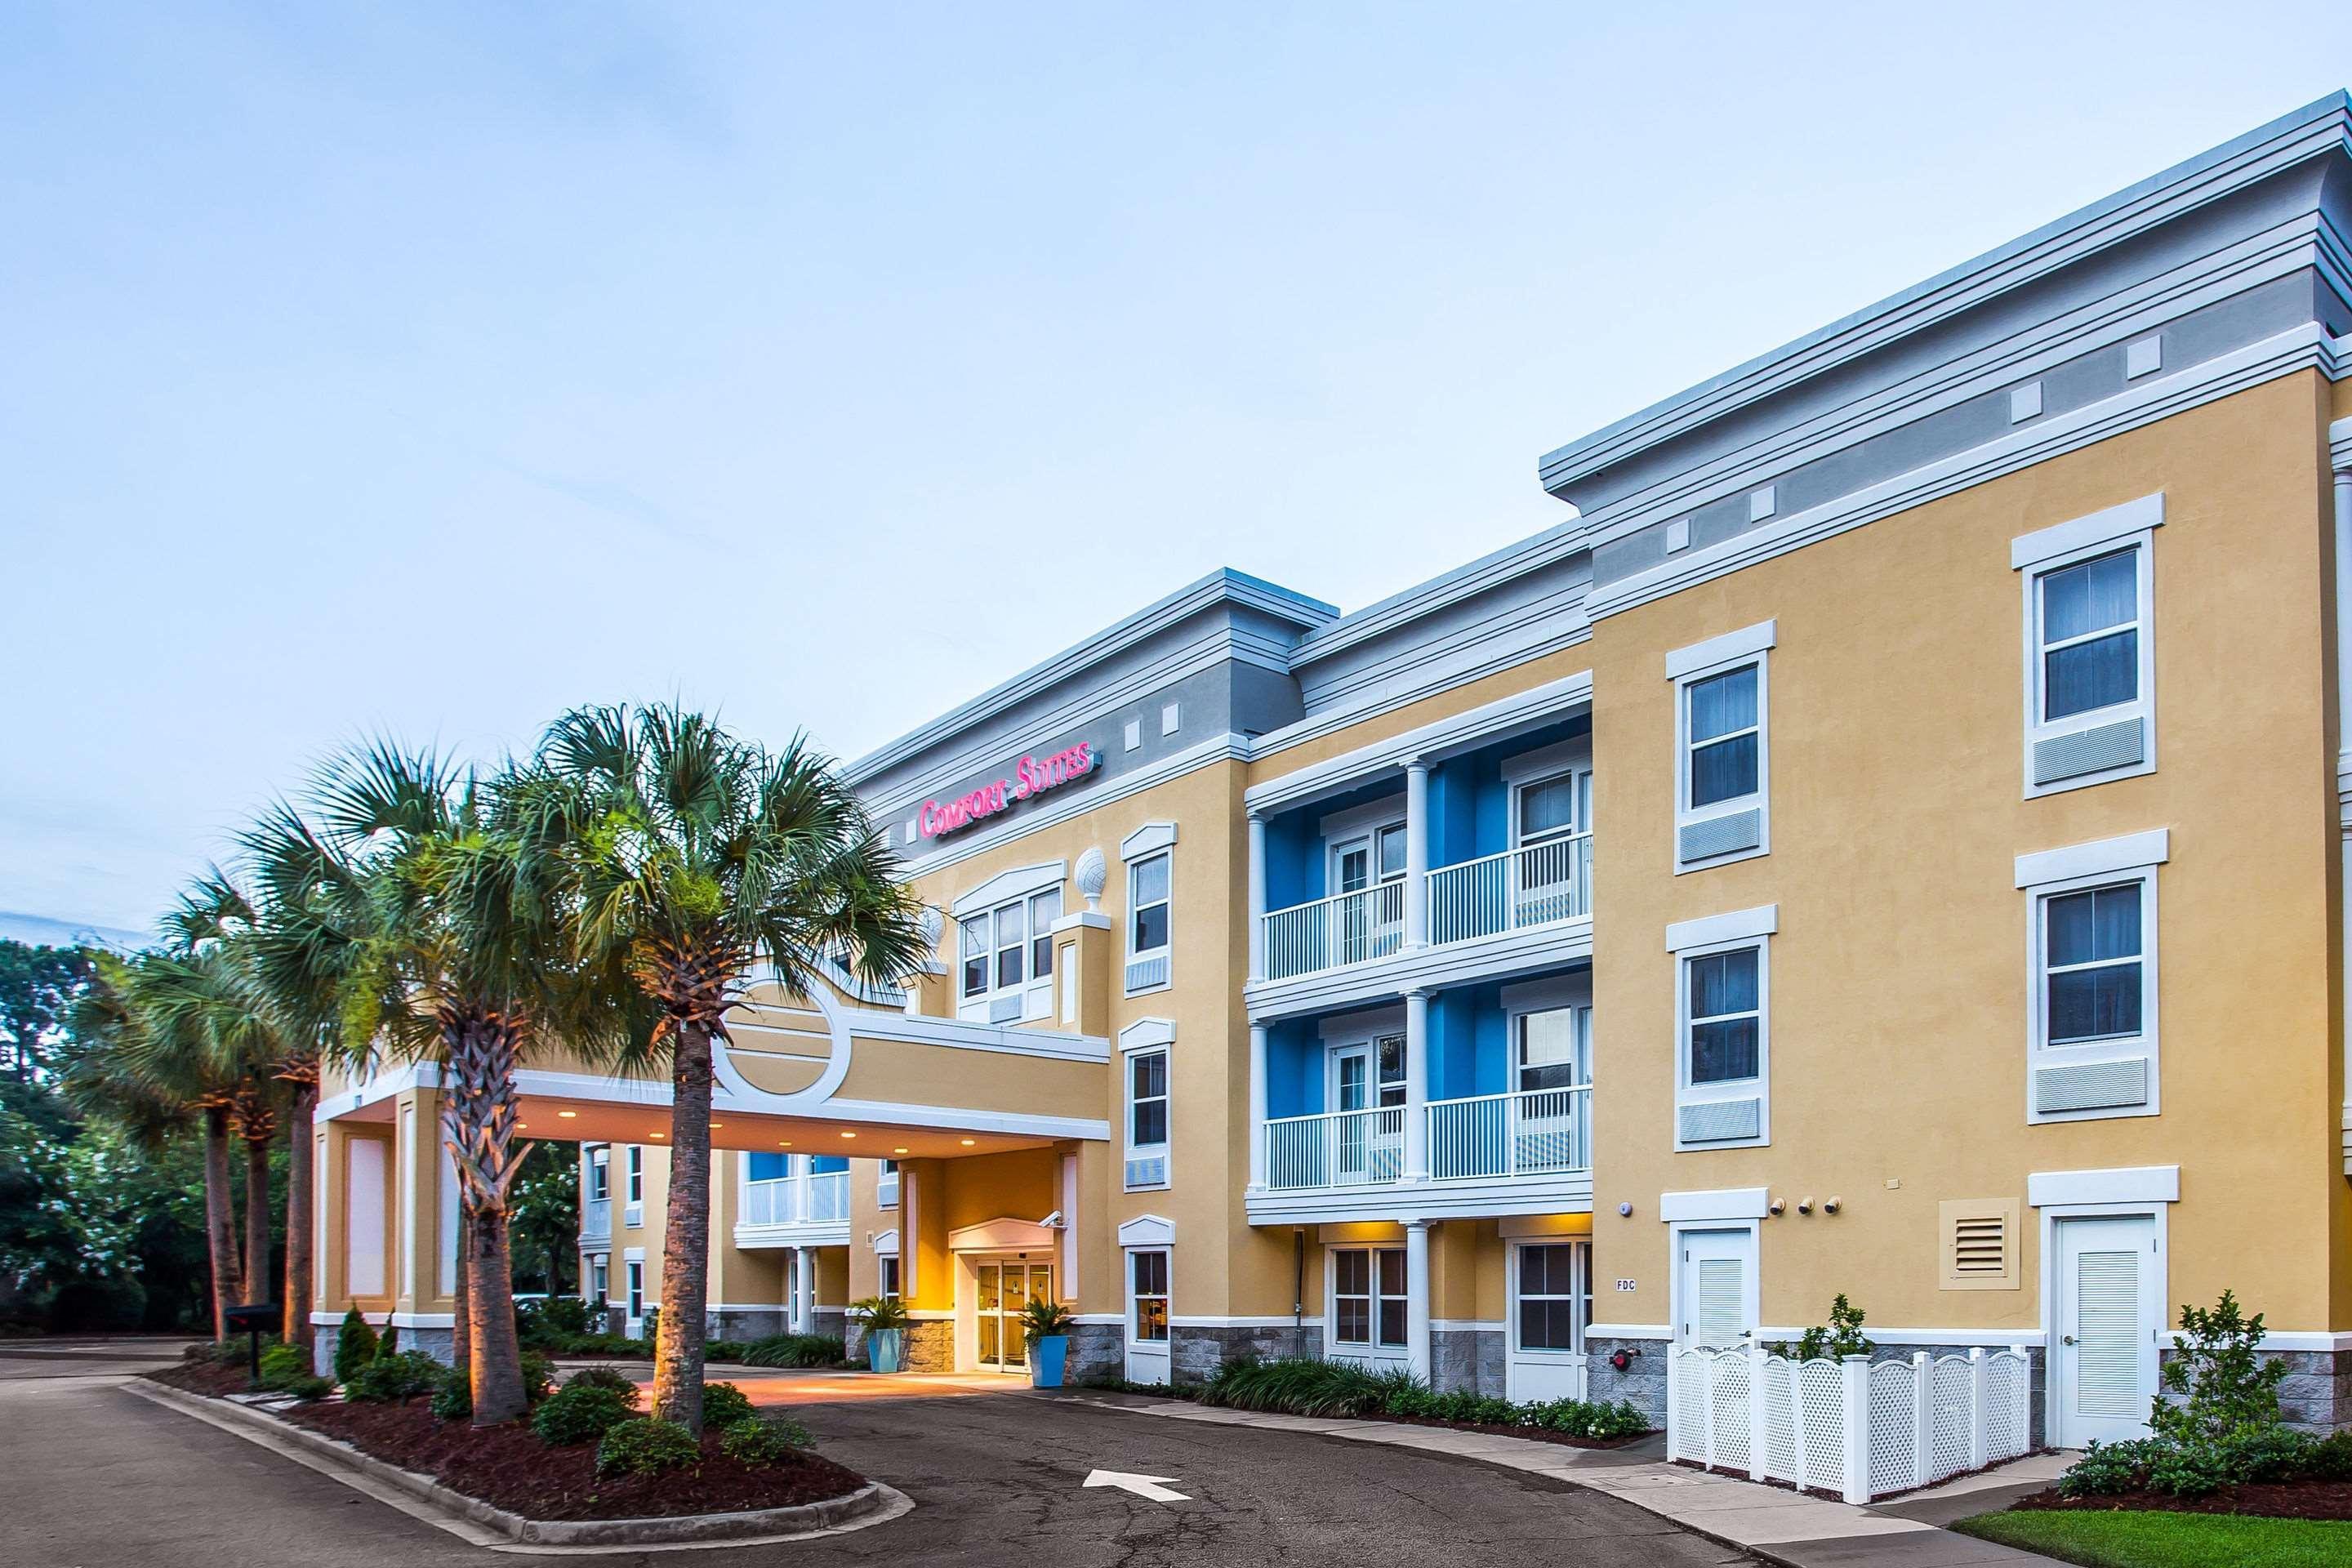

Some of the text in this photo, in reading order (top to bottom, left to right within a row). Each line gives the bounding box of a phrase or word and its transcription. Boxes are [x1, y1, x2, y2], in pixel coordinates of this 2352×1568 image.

[920, 741, 1090, 838] COMFORT SUITES
[1617, 1280, 1635, 1290] FDC
